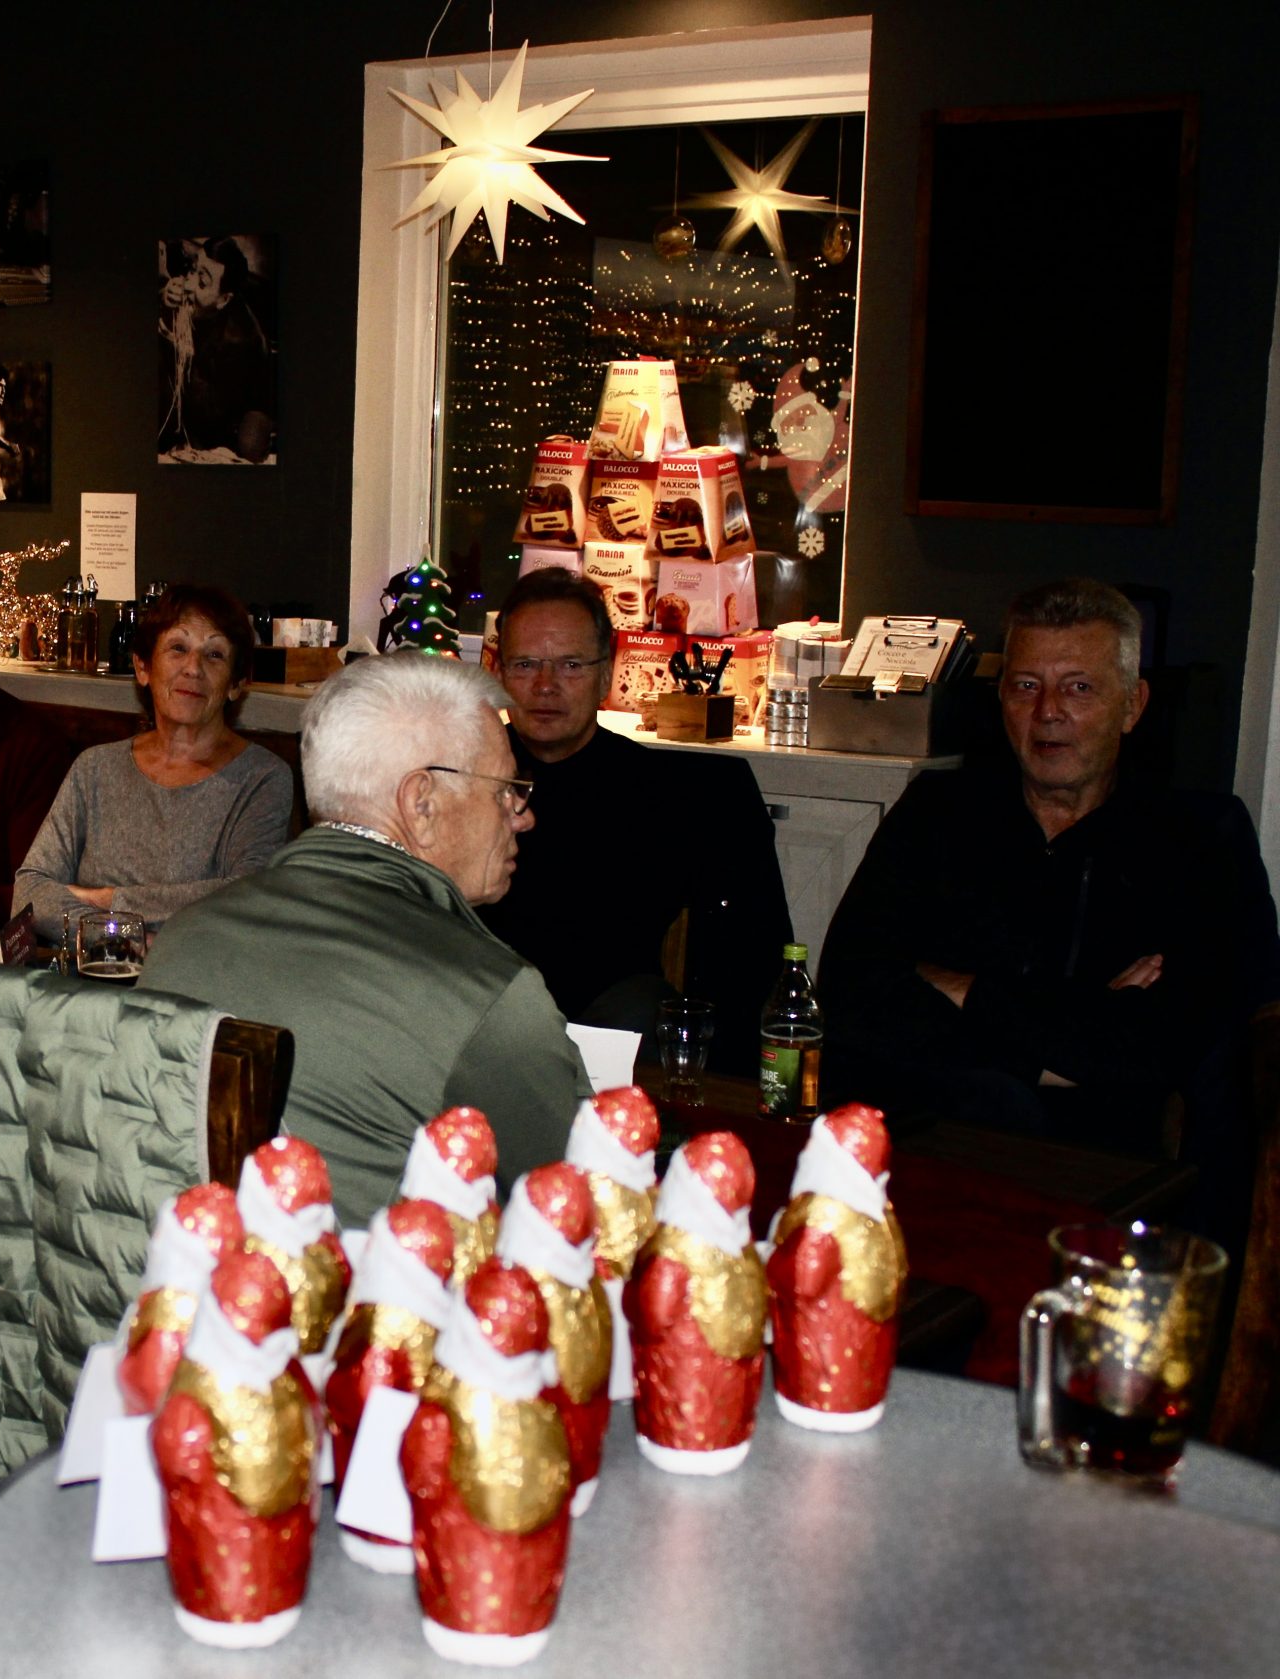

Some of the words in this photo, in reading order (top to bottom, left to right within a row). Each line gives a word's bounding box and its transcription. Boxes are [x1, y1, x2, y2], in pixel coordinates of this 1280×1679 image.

[612, 368, 639, 376] MAINA
[603, 465, 639, 473] BALOCCO
[662, 463, 699, 472] BALOCCO
[601, 482, 640, 490] MAXICIOK
[660, 481, 701, 489] MAXICIOK
[597, 549, 624, 559] MAINA
[627, 636, 664, 646] BALOCCO
